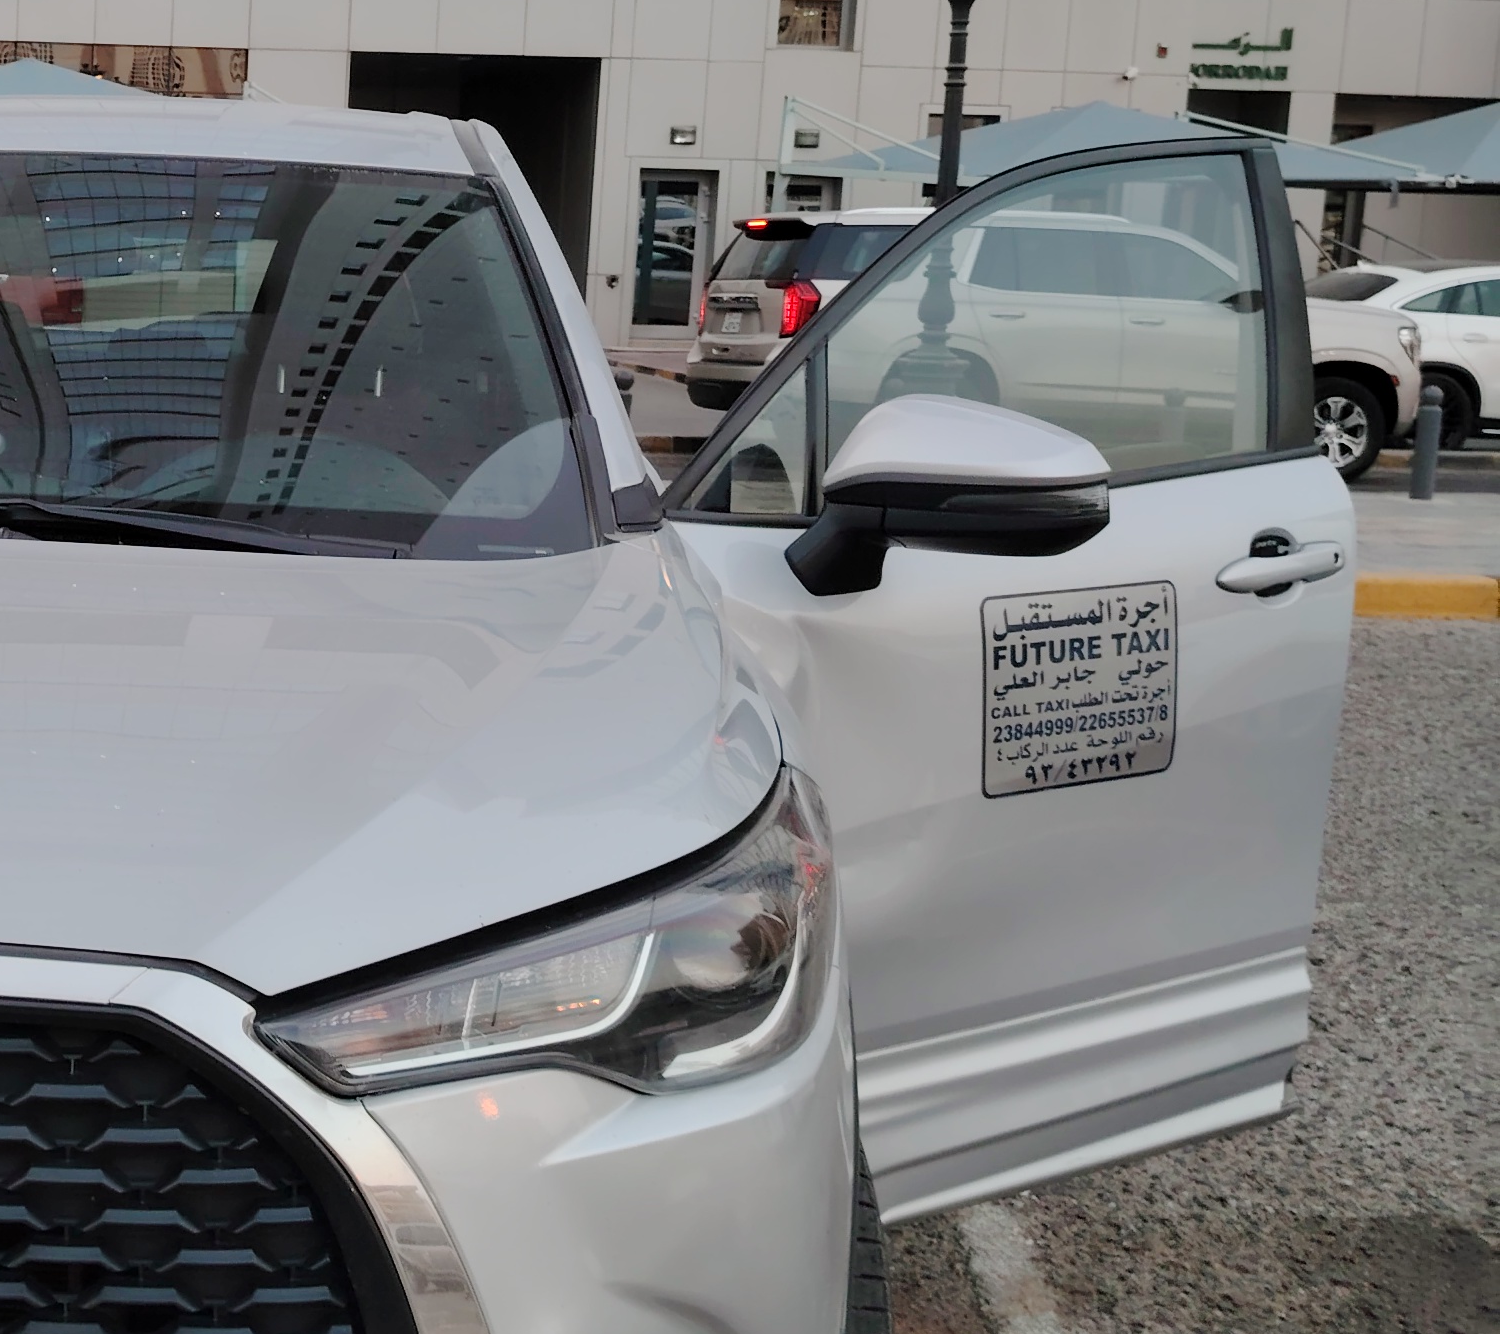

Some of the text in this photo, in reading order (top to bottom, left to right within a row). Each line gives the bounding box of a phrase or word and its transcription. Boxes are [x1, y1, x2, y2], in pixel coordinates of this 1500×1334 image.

[993, 585, 1168, 642] أجرة المستقبل
[993, 628, 1169, 670] FUTURE TAXI
[993, 658, 1168, 701] حولي جابر العلي
[1071, 691, 1108, 713] الطلب
[1111, 685, 1139, 704] تحت
[991, 699, 1070, 720] CALL TAXI
[1053, 742, 1079, 755] عدد
[1086, 731, 1132, 750] اللوحة
[1006, 742, 1048, 765] الركاب
